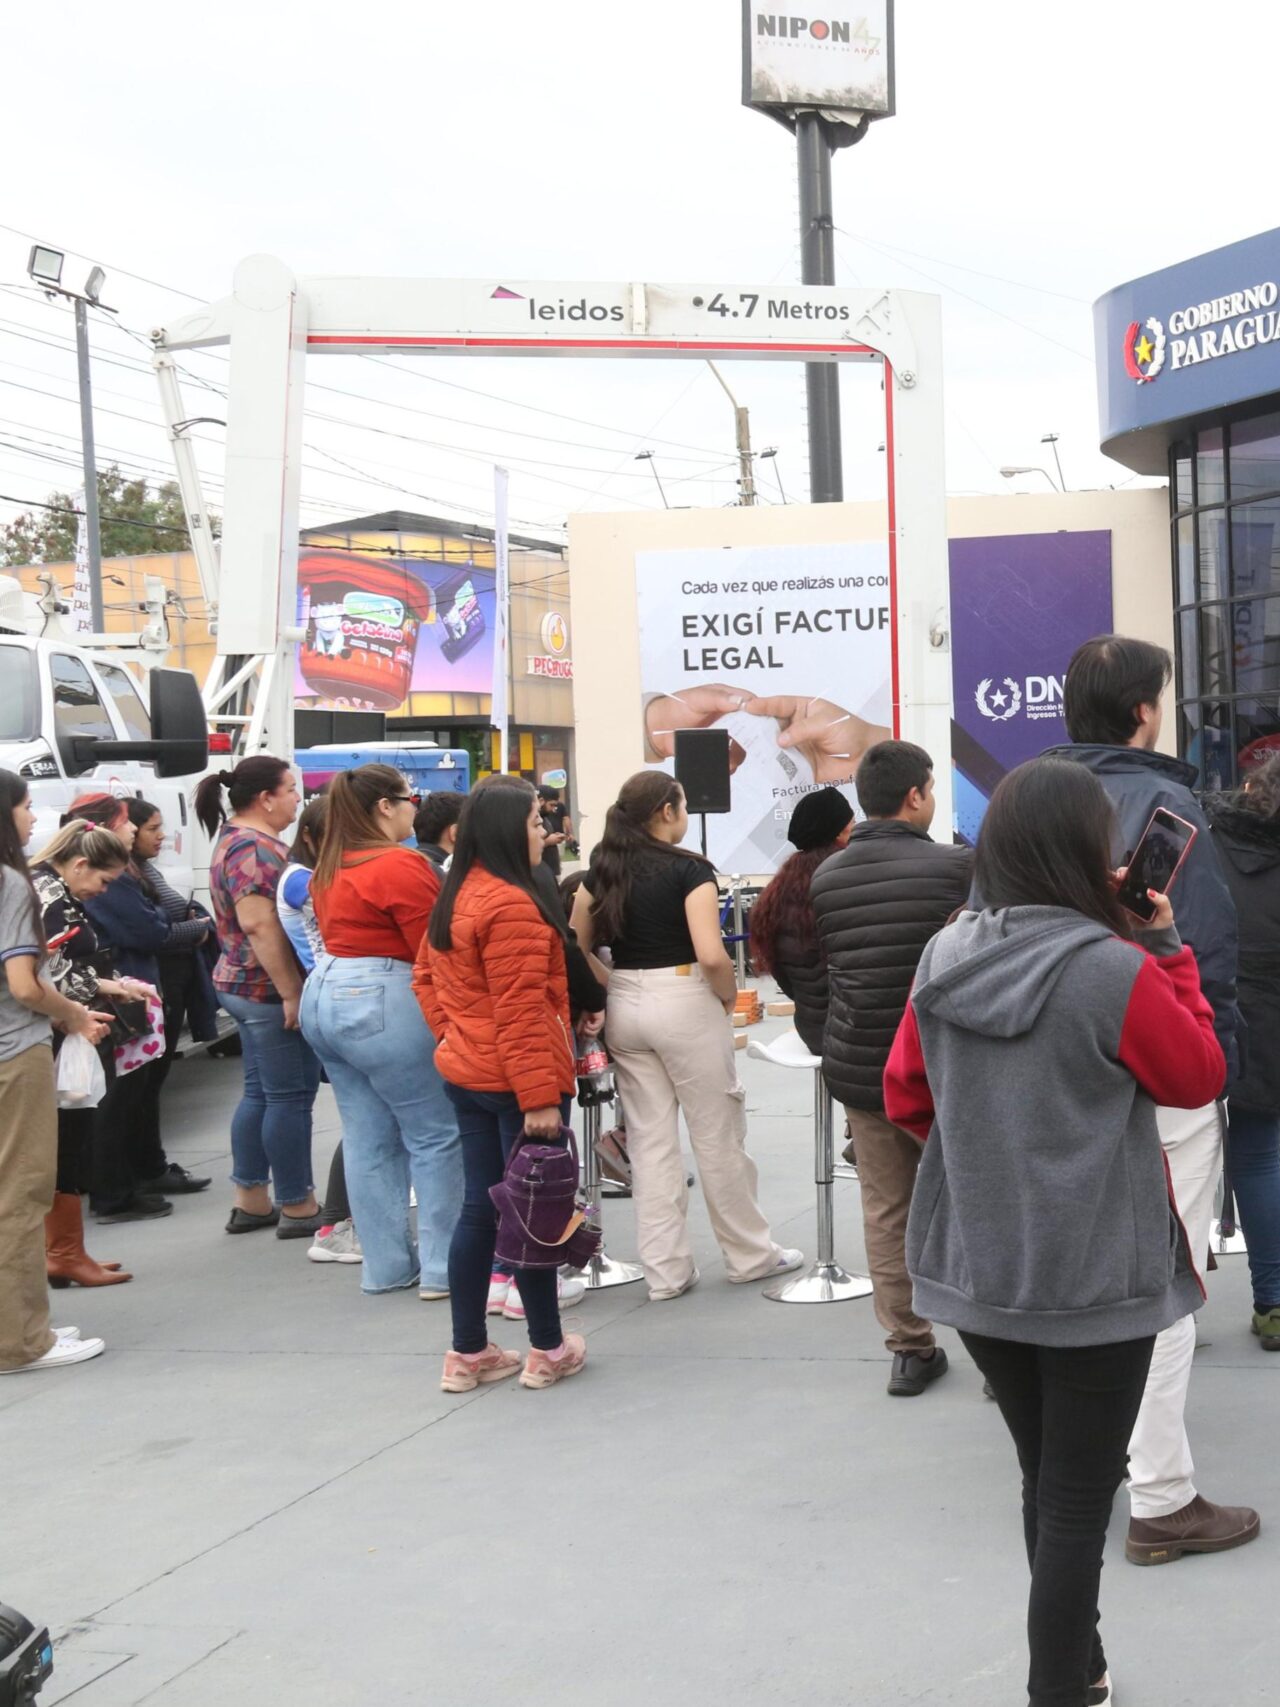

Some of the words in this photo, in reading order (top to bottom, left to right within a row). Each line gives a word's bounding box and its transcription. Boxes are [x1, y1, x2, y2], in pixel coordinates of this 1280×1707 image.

[757, 14, 850, 43] NIPON
[528, 298, 625, 322] leidos
[707, 293, 759, 318] 4.7
[768, 300, 850, 321] Metros
[1169, 281, 1278, 335] GOBIERNO
[681, 580, 718, 595] Cada
[722, 581, 748, 593] vez
[752, 579, 778, 595] que
[782, 576, 835, 590] realizás
[838, 576, 864, 588] una
[682, 607, 764, 638] EXIGÍ
[683, 646, 784, 671] LEGAL
[1026, 712, 1057, 720] Ingresos
[772, 783, 820, 798] Factura
